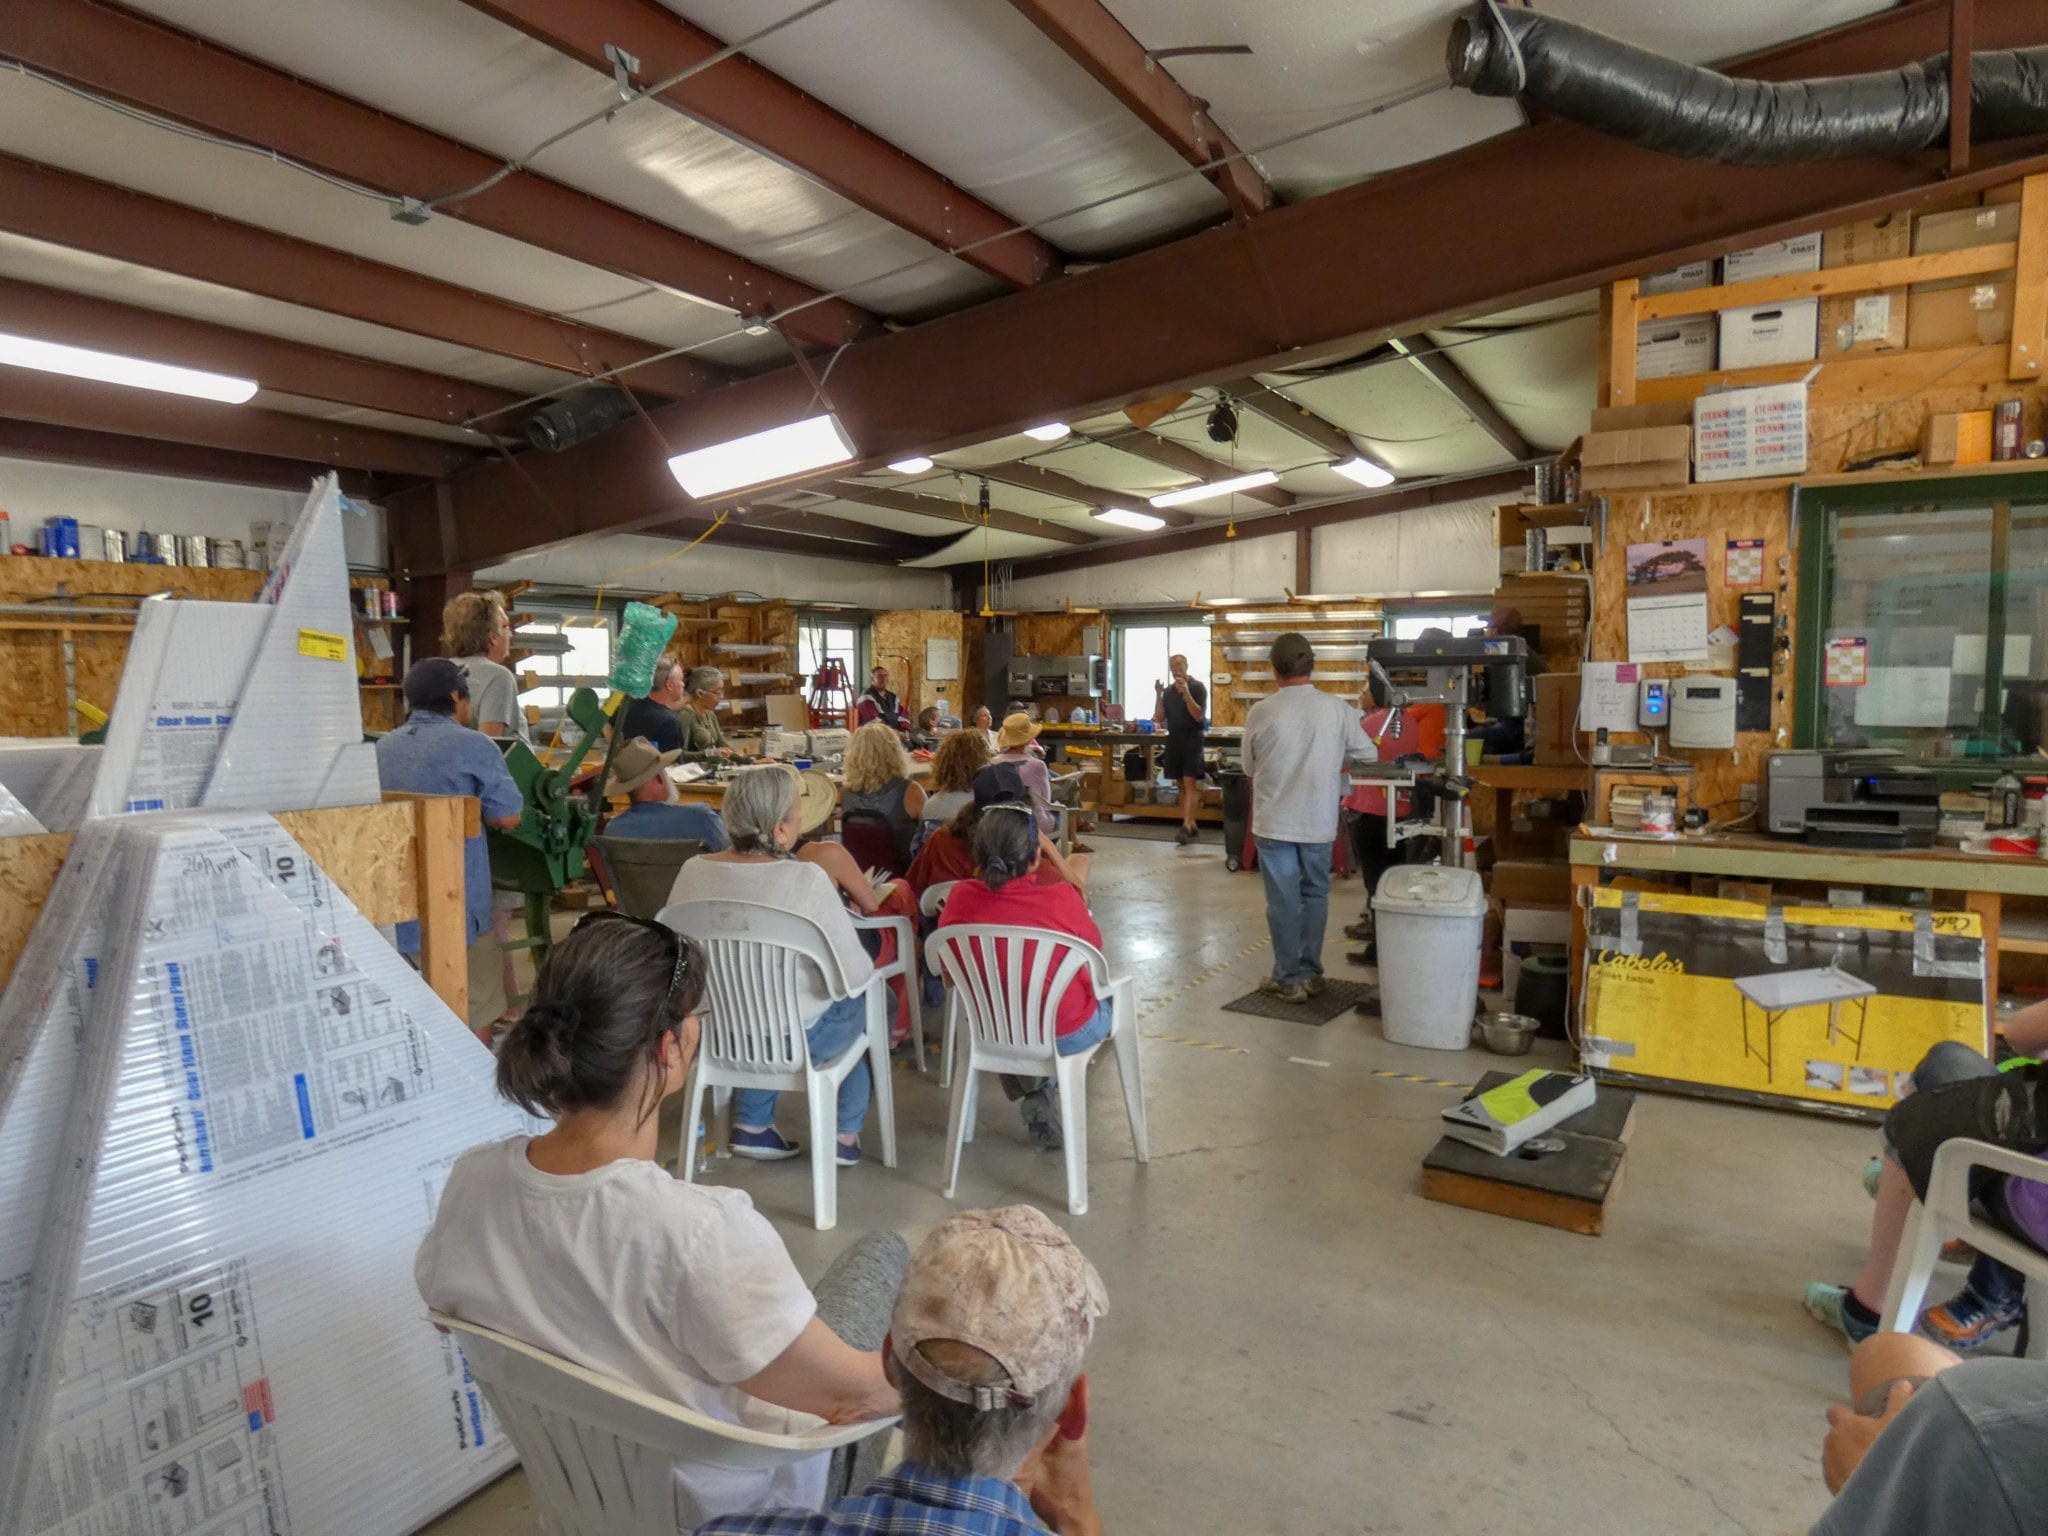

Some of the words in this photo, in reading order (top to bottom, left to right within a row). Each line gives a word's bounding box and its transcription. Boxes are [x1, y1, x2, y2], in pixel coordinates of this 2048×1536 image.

[276, 856, 296, 883] 10
[1598, 949, 1684, 975] Cabela's
[165, 962, 184, 994] Panel
[173, 996, 189, 1030] Storm
[187, 1072, 201, 1101] Clear
[189, 1293, 214, 1327] 10
